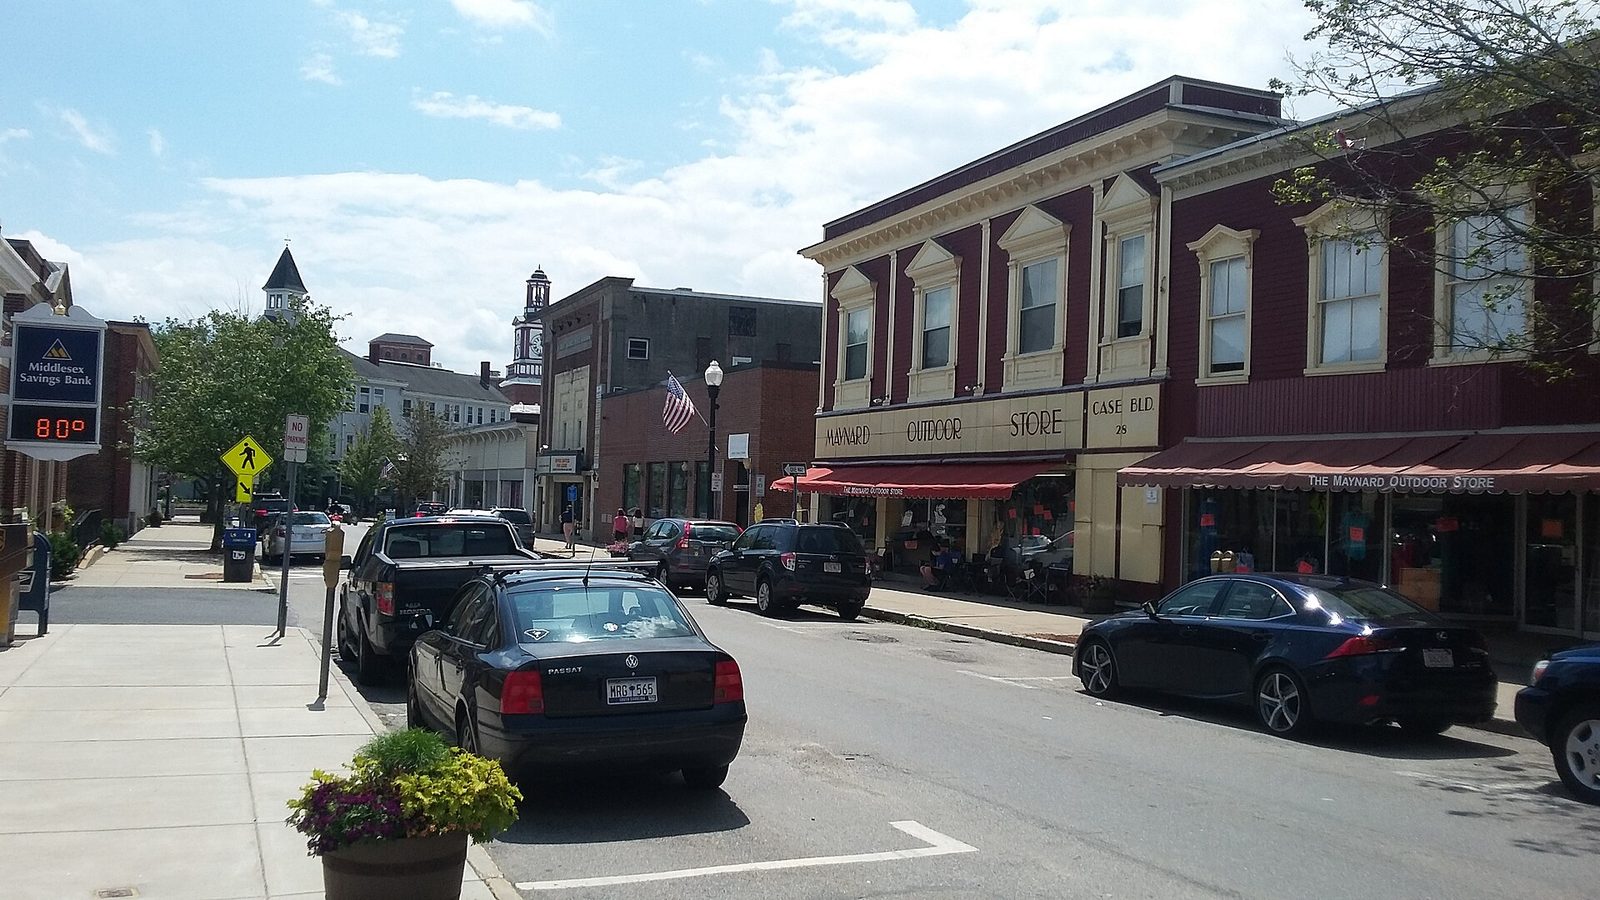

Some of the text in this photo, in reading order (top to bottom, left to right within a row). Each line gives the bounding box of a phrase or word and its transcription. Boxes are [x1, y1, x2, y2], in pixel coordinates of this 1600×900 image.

[28, 362, 84, 374] Middlesex
[20, 372, 92, 386] Savings Bank
[1092, 397, 1155, 416] CASE BLD.
[292, 422, 303, 431] NO
[825, 409, 1062, 446] MAYNARD OUTDOOR STORE
[1115, 425, 1128, 435] 28
[286, 435, 306, 443] PARKING
[1308, 474, 1495, 488] THE MAYNARD OUTDOOR STORE
[548, 666, 583, 675] PASSAT
[636, 683, 654, 696] 565
